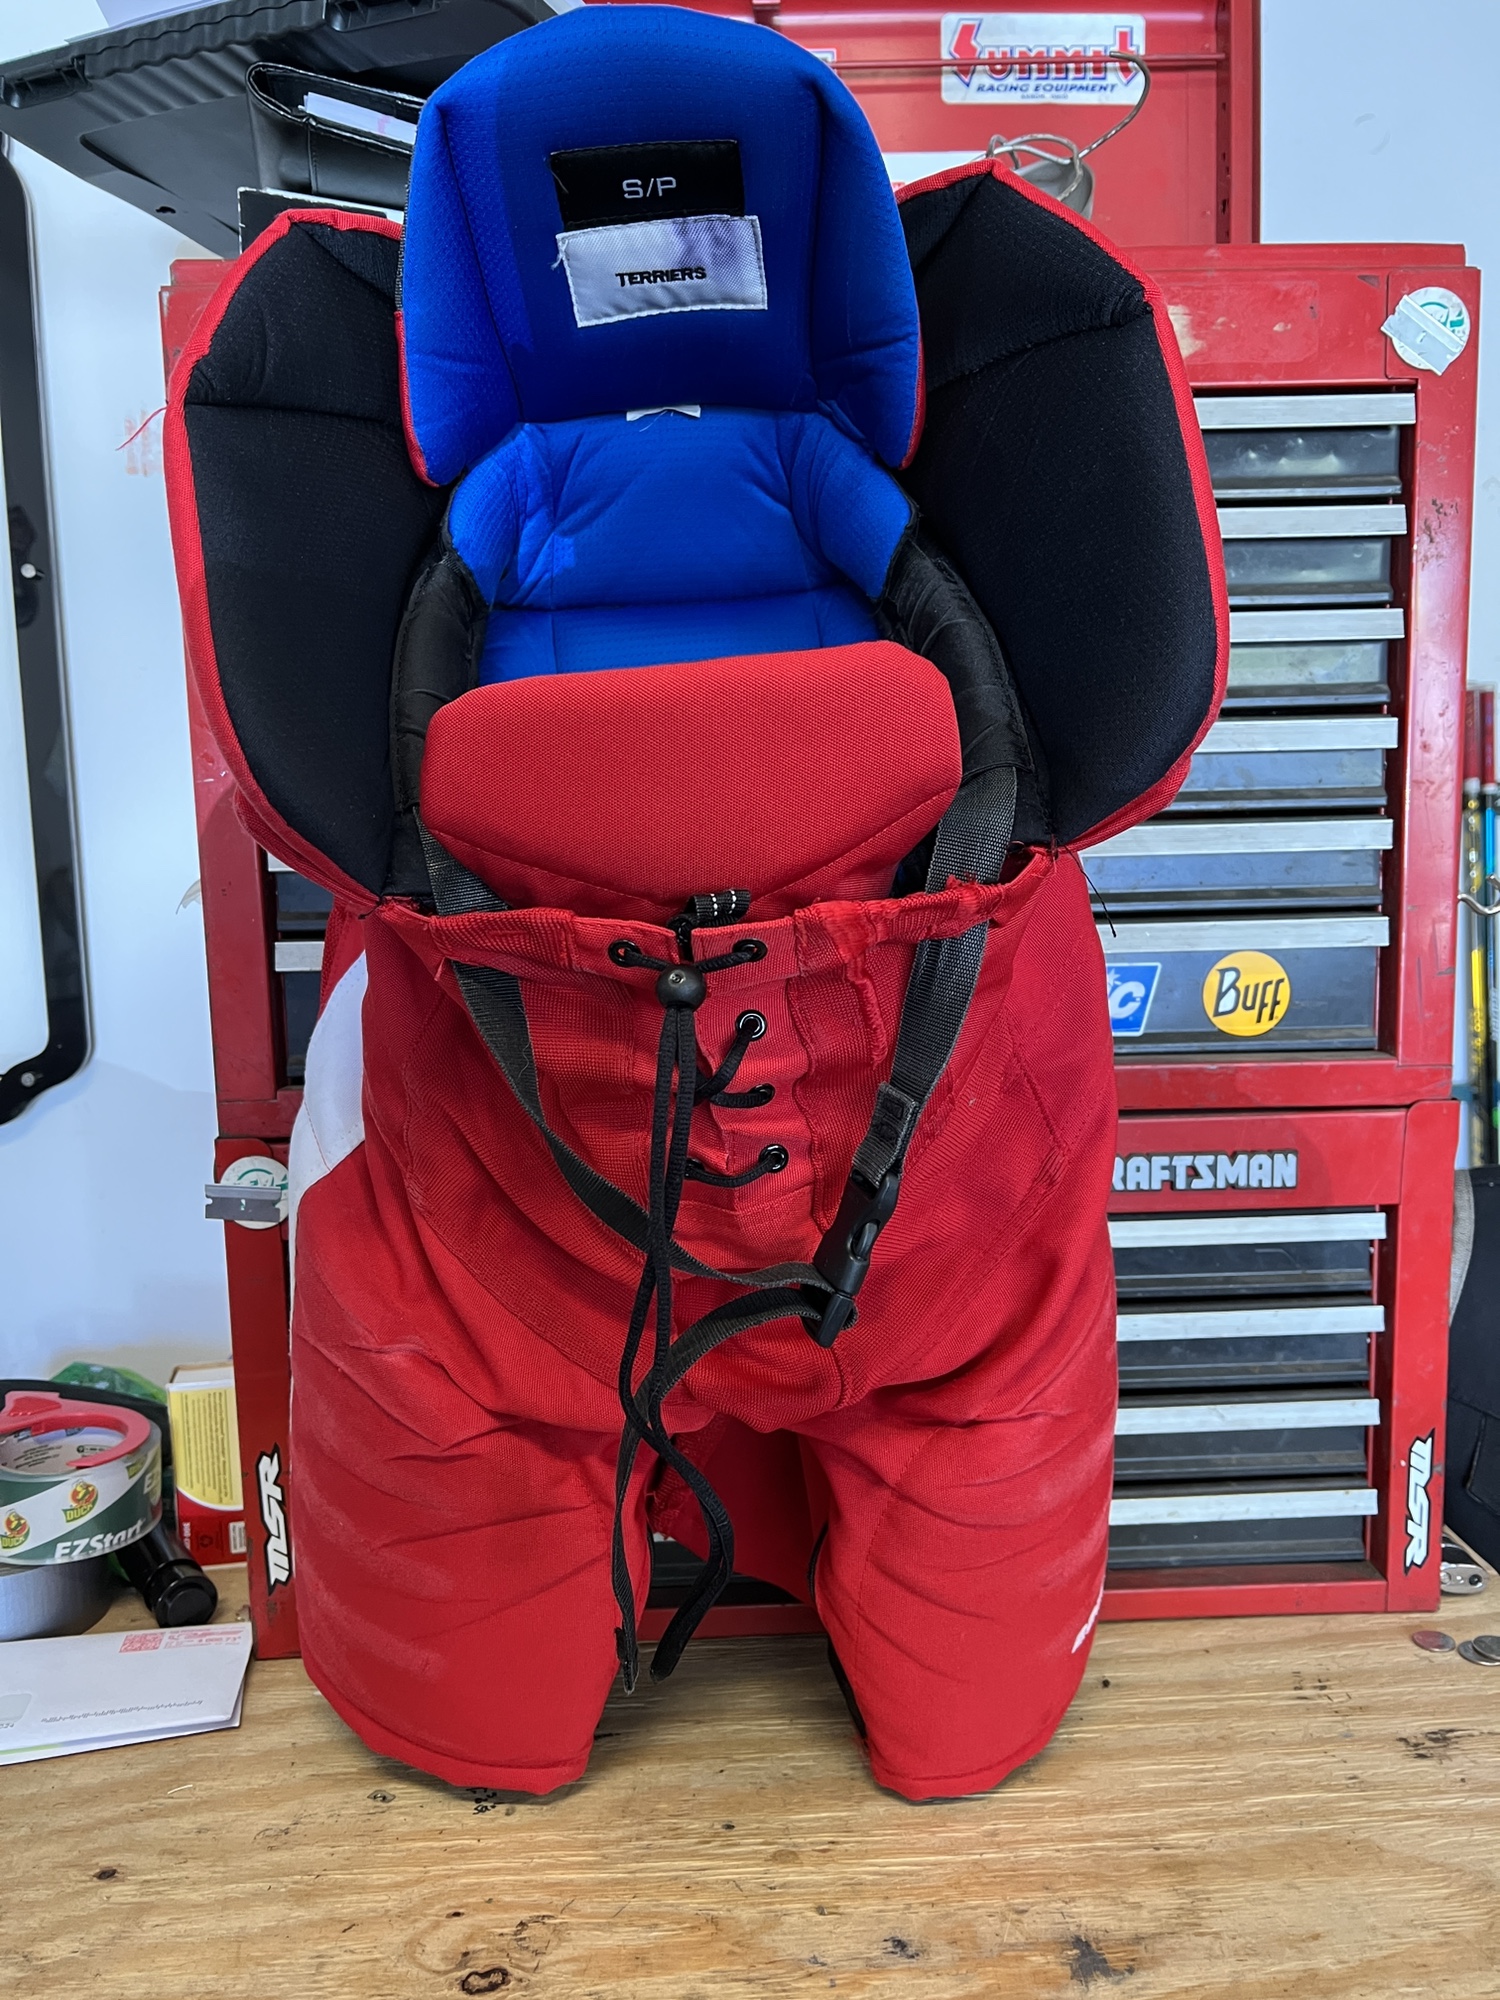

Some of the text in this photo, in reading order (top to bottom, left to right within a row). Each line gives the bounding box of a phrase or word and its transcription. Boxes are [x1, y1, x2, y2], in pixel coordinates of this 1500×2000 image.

[976, 82, 1119, 94] RACING EQUIPMENT
[622, 176, 677, 199] S/P
[615, 266, 707, 287] TERRIERS
[54, 1518, 143, 1559] EZStart
